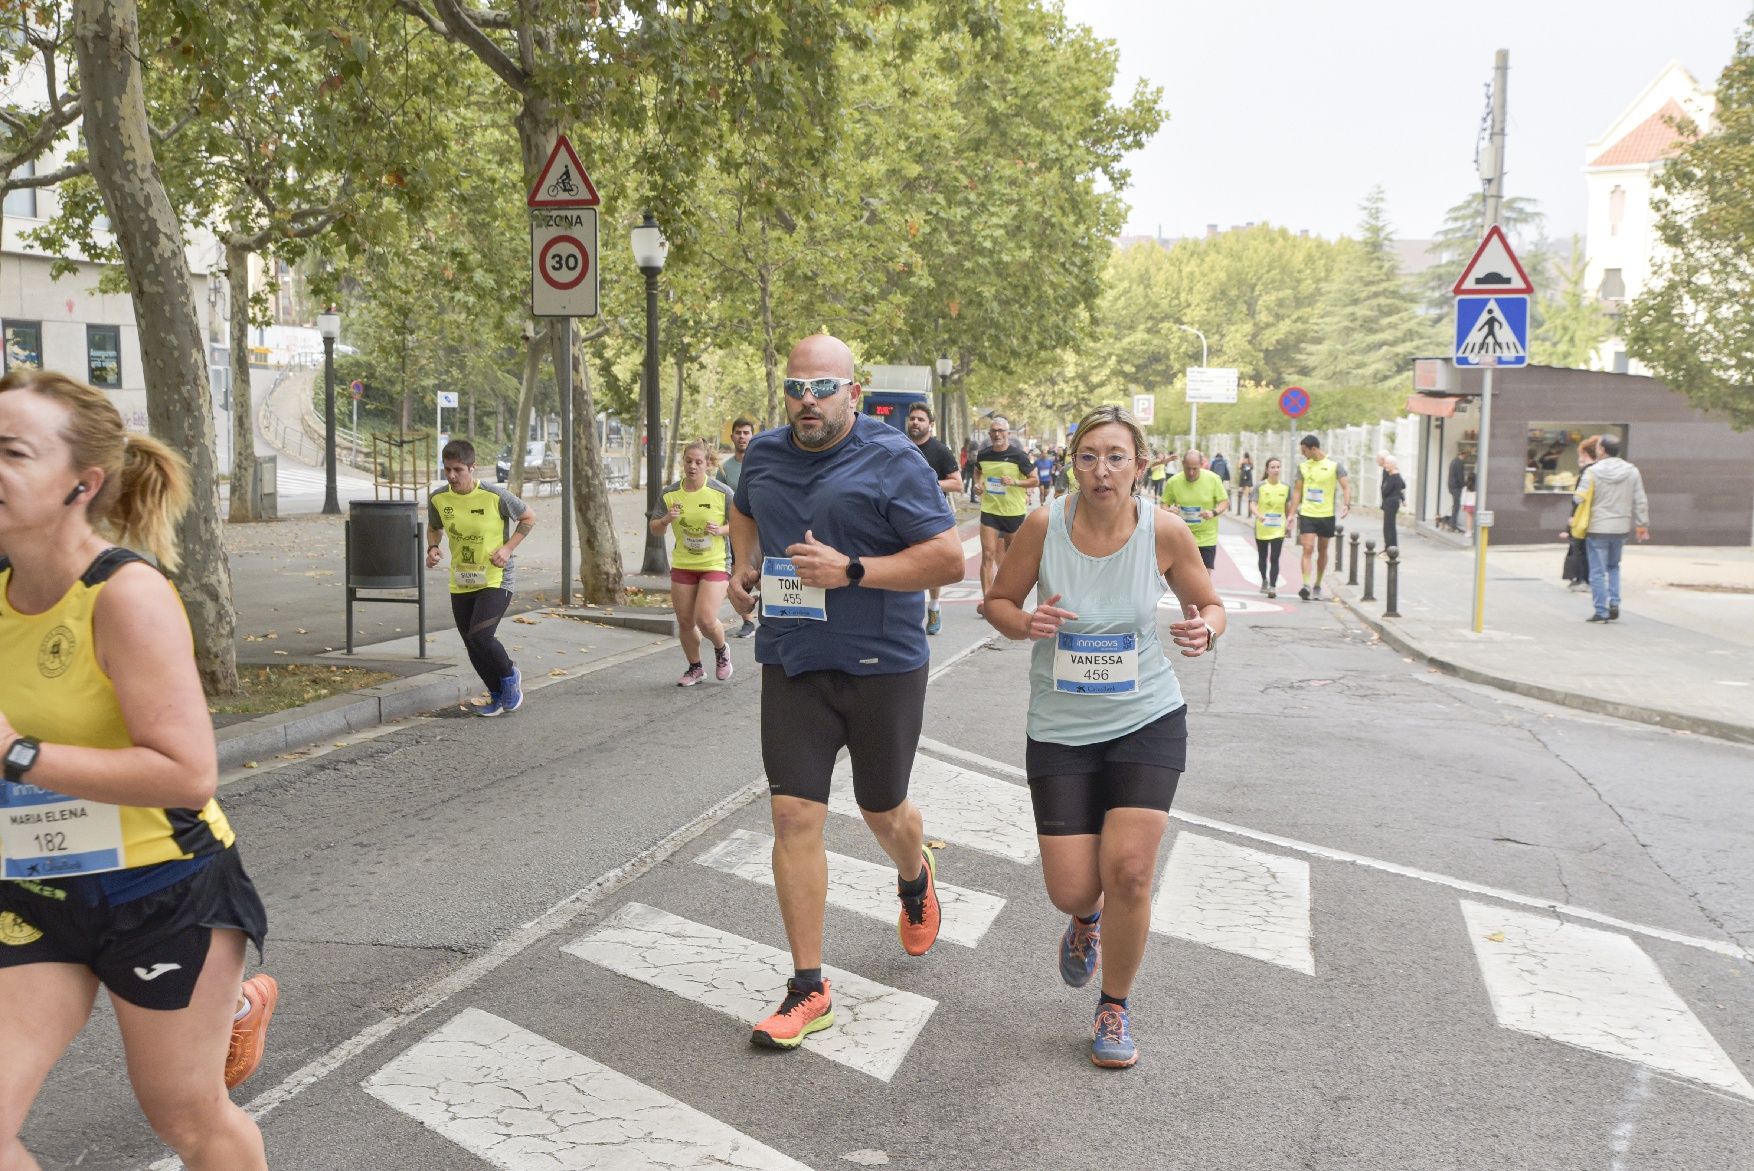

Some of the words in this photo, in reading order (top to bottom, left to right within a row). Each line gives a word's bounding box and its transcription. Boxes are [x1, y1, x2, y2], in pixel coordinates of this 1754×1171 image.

[546, 214, 583, 227] ZONA
[551, 253, 579, 271] 30
[1139, 400, 1149, 414] P
[774, 563, 796, 571] inmo
[783, 593, 802, 605] 455
[1076, 639, 1118, 648] inmoovs
[1070, 654, 1123, 665] VANESSA
[1083, 669, 1109, 681] 456
[9, 814, 43, 826] MARIA
[45, 807, 88, 823] ELENA
[33, 831, 68, 852] 182
